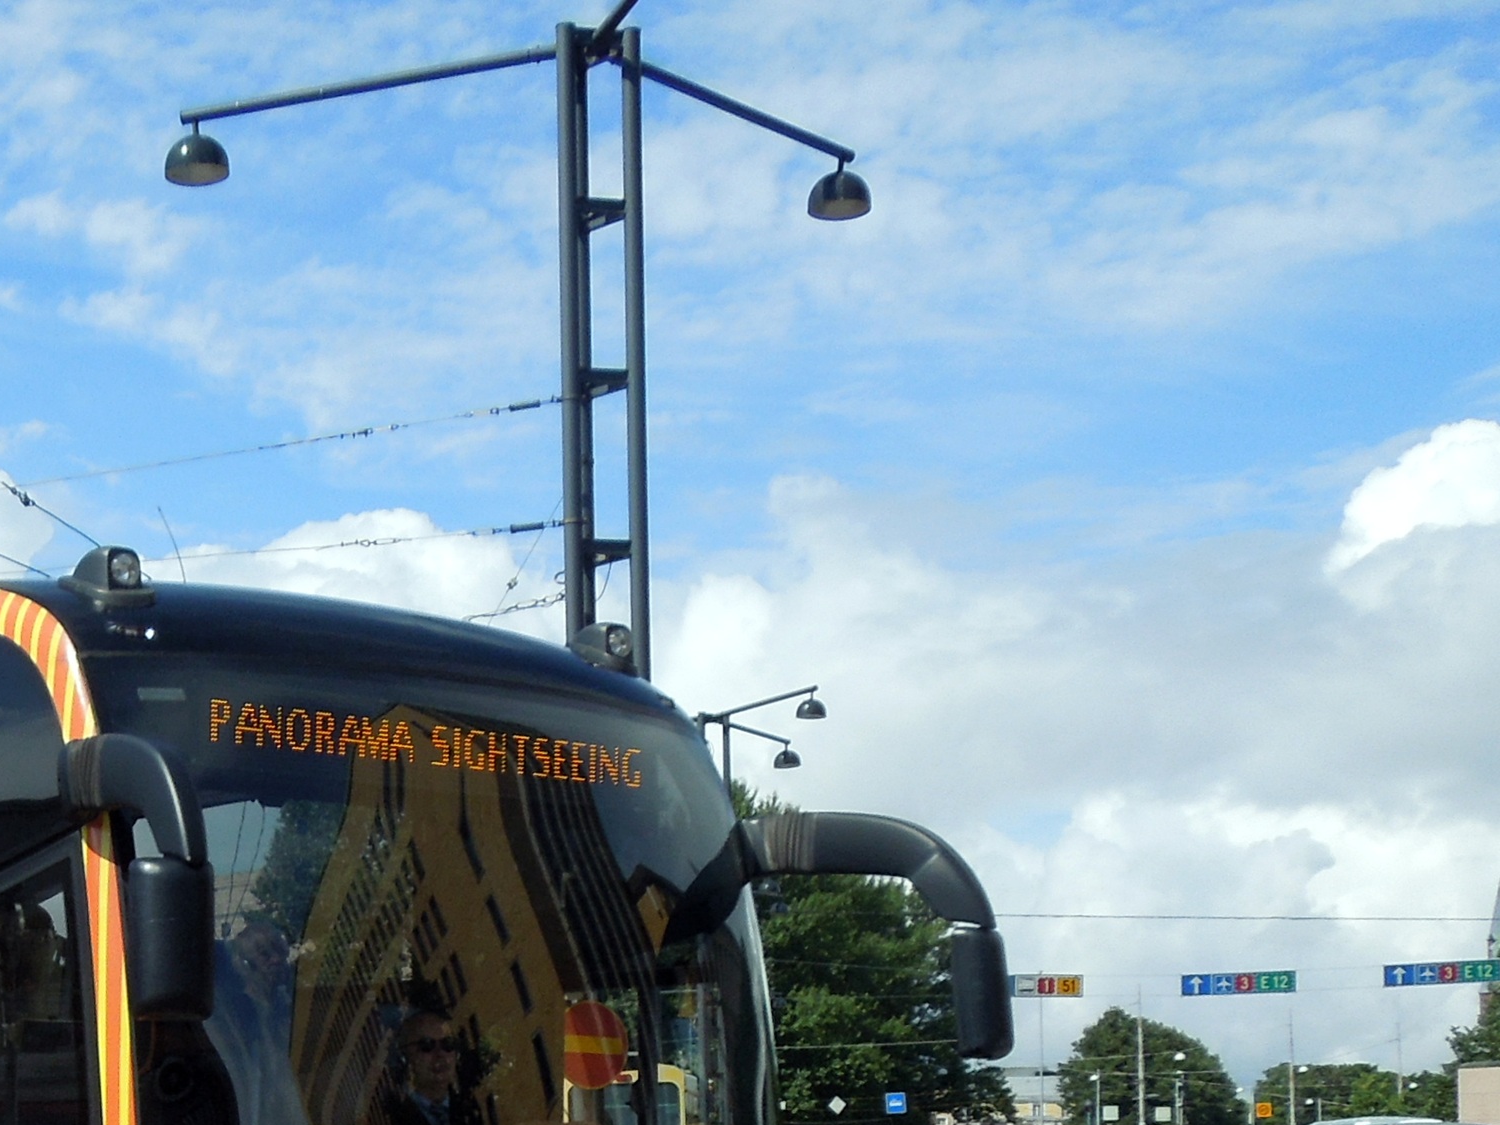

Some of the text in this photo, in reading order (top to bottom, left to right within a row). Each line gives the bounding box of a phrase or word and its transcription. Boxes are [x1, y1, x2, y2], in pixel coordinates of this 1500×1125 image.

[210, 699, 641, 788] PANORAMA SIGHTSEEING
[1444, 964, 1493, 980] 3 E 12
[1062, 980, 1076, 993] 51
[1240, 974, 1289, 990] 3 E 12
